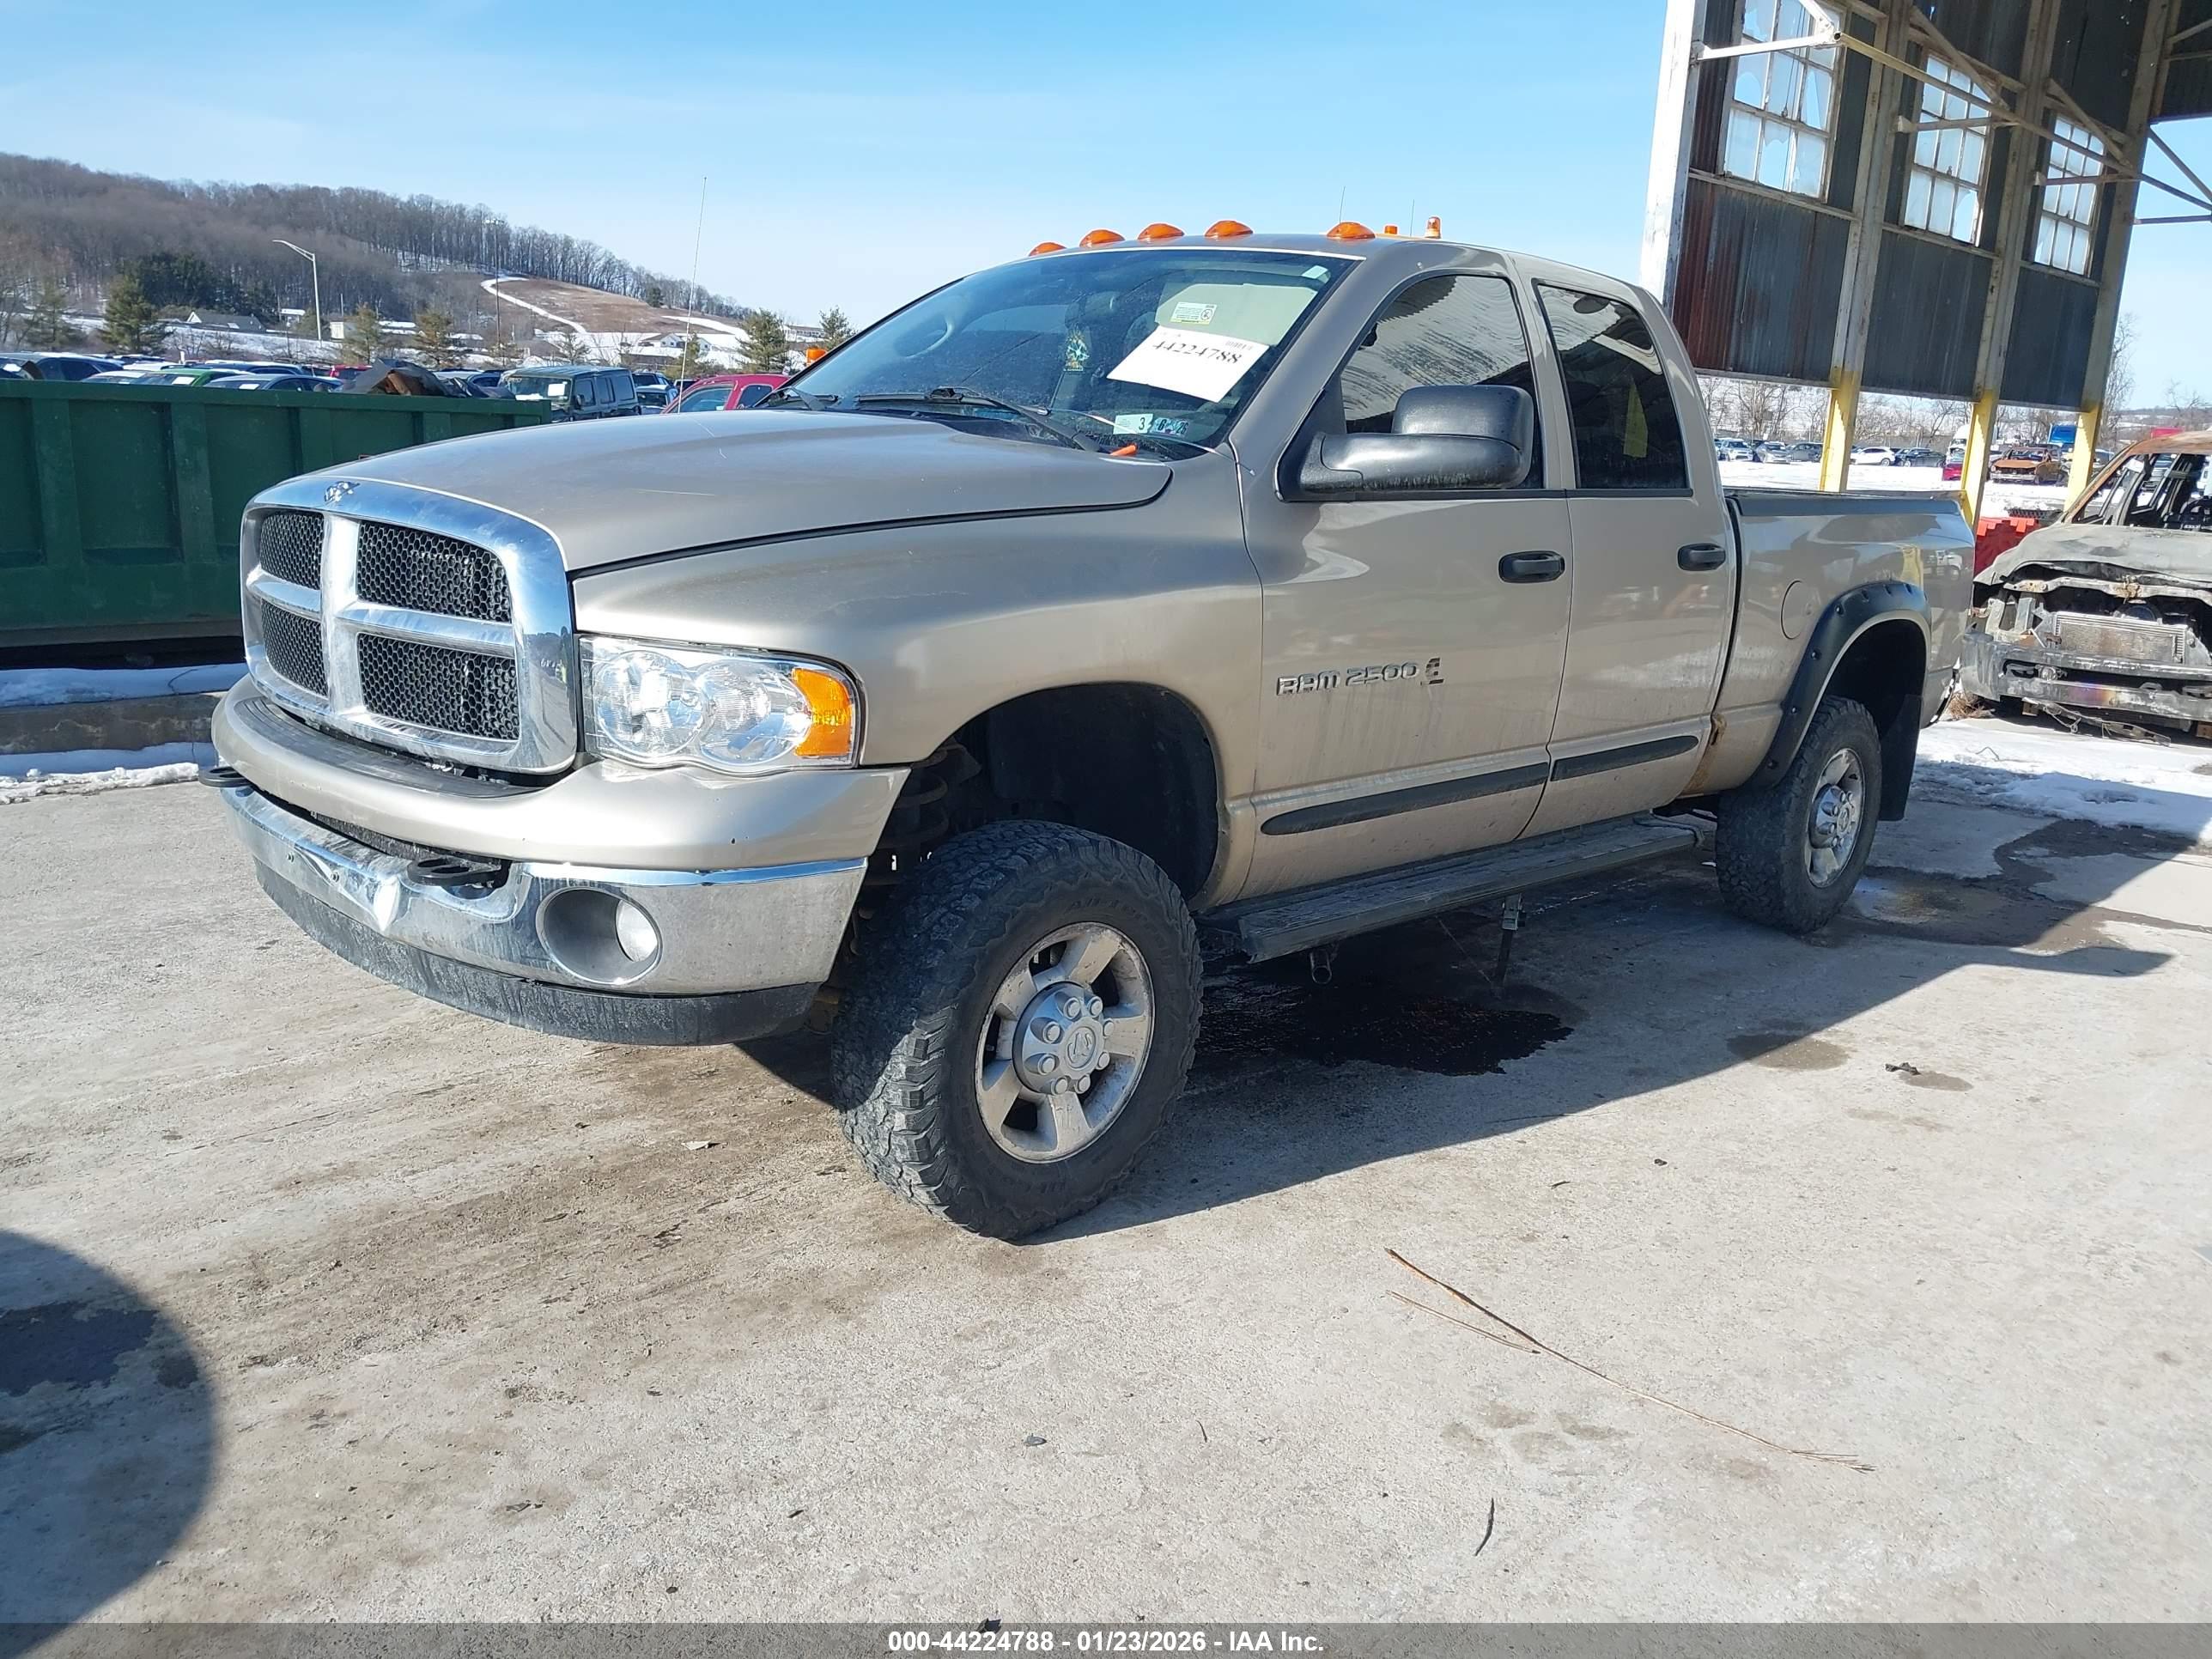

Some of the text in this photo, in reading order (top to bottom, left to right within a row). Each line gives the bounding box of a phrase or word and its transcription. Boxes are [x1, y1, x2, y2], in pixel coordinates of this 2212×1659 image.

[1153, 341, 1242, 363] 44224788
[1138, 417, 1146, 430] 3
[1277, 661, 1419, 696] RAM 2500
